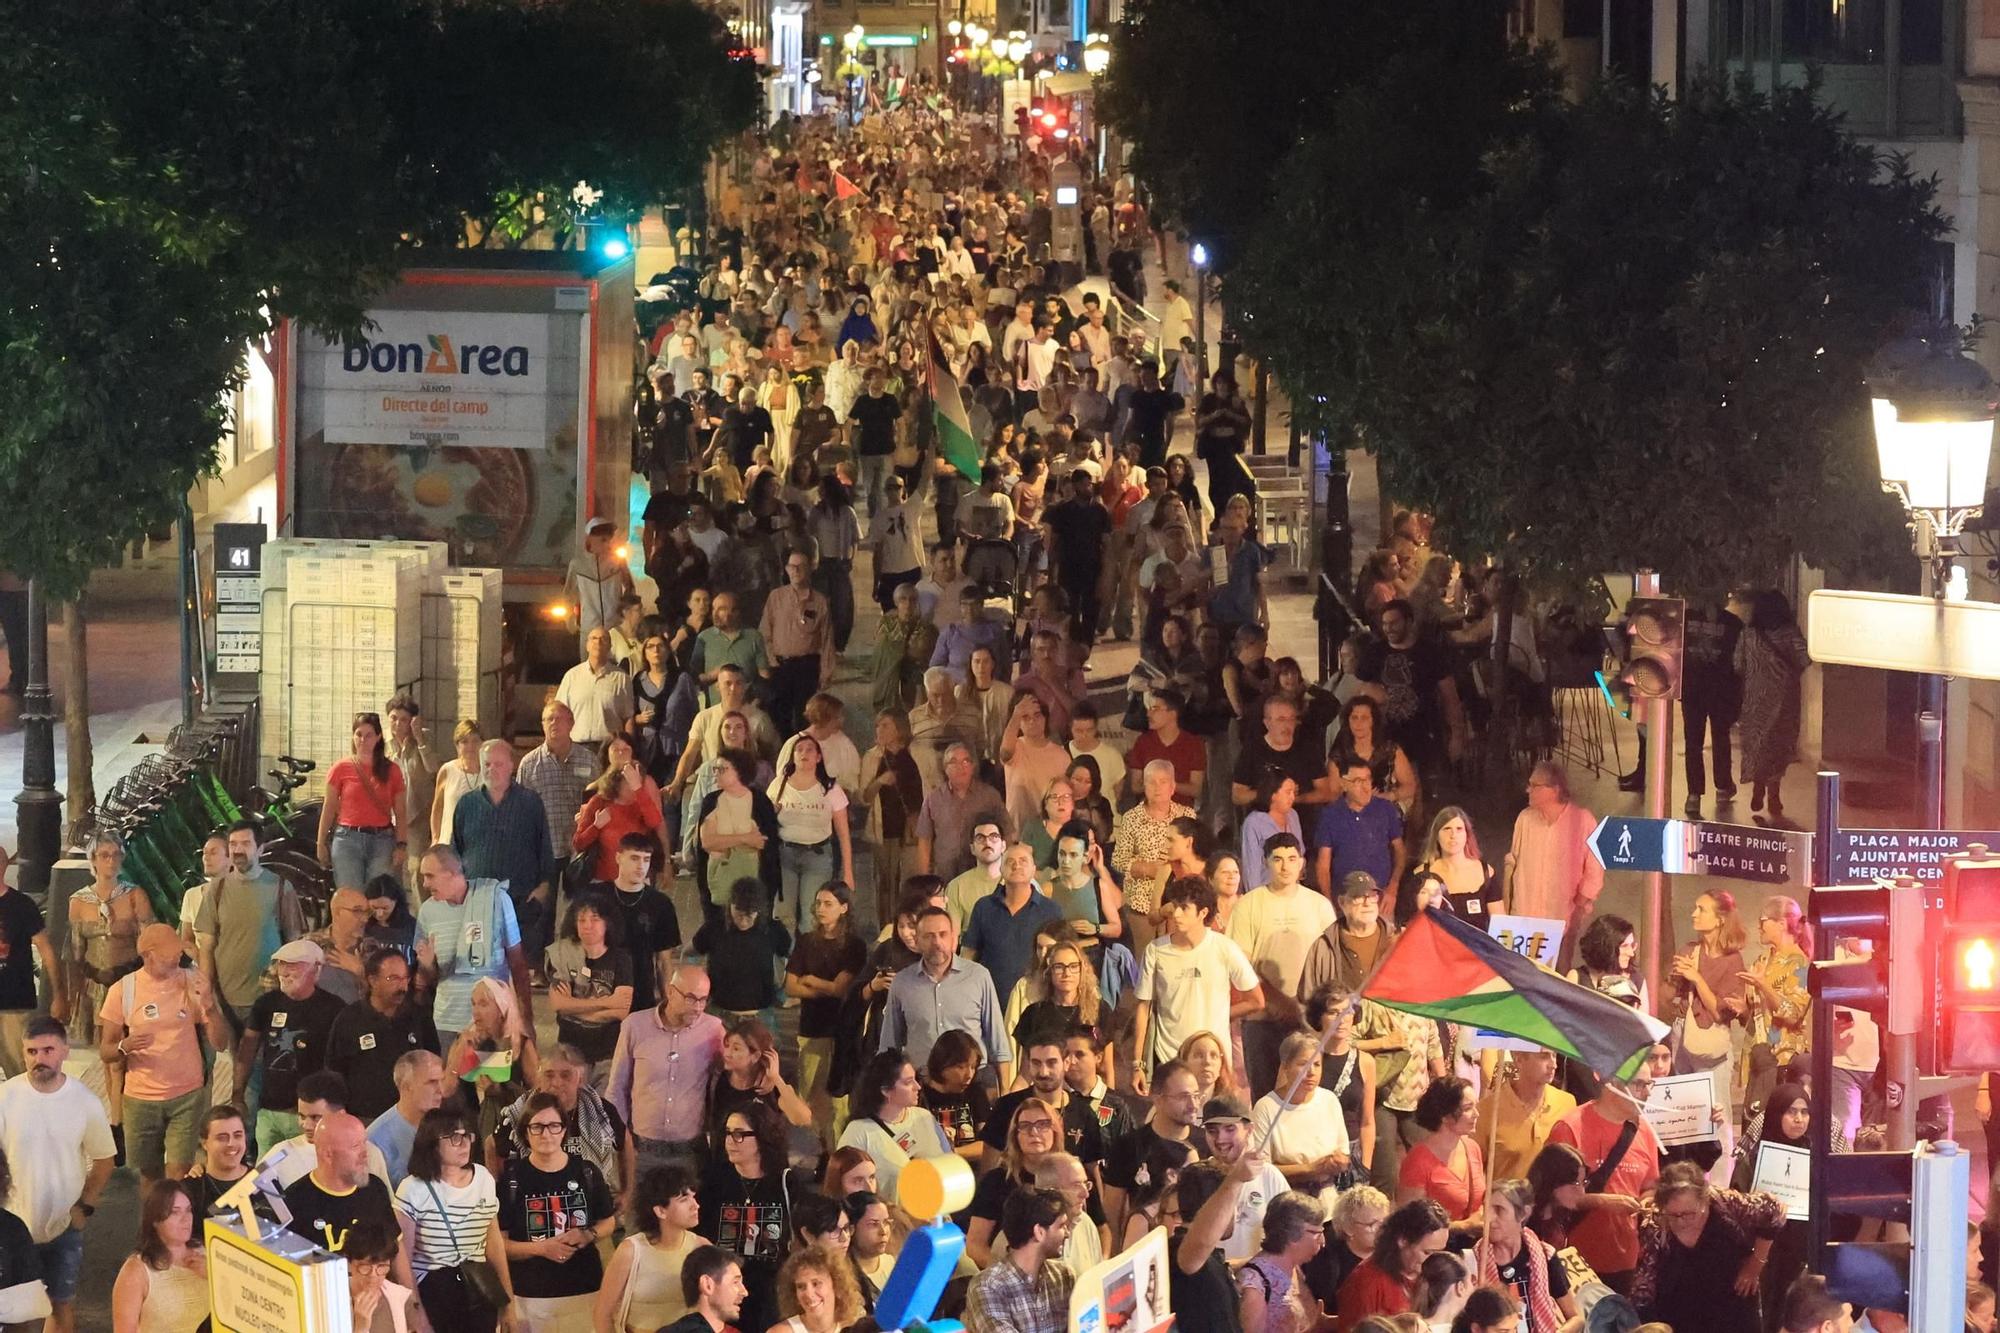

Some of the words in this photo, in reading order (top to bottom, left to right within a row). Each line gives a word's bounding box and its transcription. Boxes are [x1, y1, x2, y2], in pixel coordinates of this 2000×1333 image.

[382, 396, 428, 413] Directe
[430, 397, 450, 413] del
[452, 400, 488, 416] camp
[231, 549, 250, 567] 41
[1699, 831, 1741, 847] TEATRE
[1848, 835, 1900, 848] PLAÇA
[1907, 836, 1959, 848] MAJOR
[1697, 853, 1736, 868] PLAÇA
[1741, 859, 1755, 870] DE
[1760, 861, 1774, 873] LA
[1848, 866, 1908, 879] MERCAT
